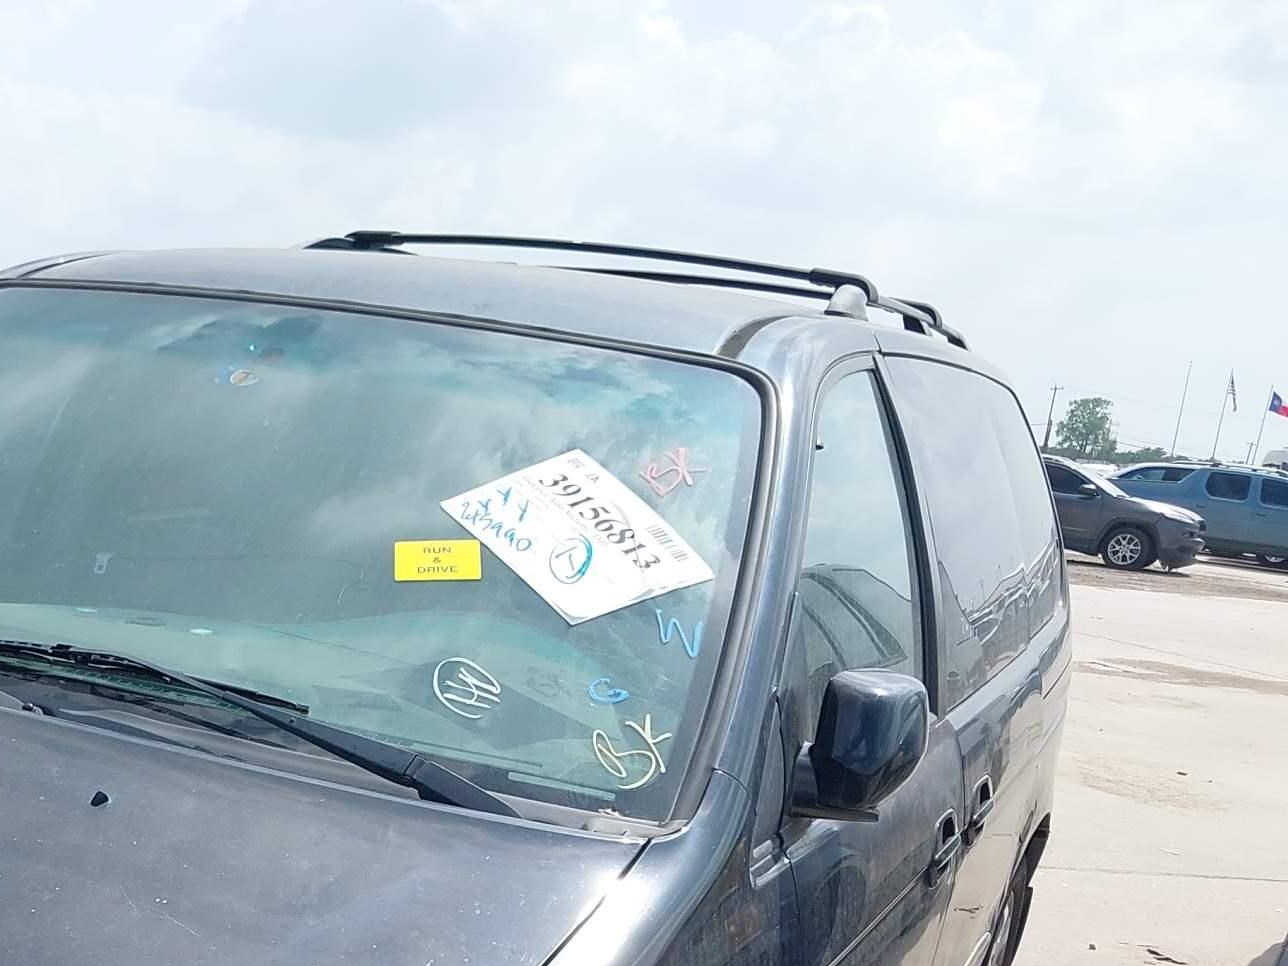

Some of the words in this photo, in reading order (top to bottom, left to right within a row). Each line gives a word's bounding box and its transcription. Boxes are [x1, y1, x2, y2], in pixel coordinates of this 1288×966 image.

[539, 473, 661, 569] 39156813
[423, 546, 452, 554] RUN
[432, 556, 442, 564] &
[417, 565, 458, 574] DRIVE
